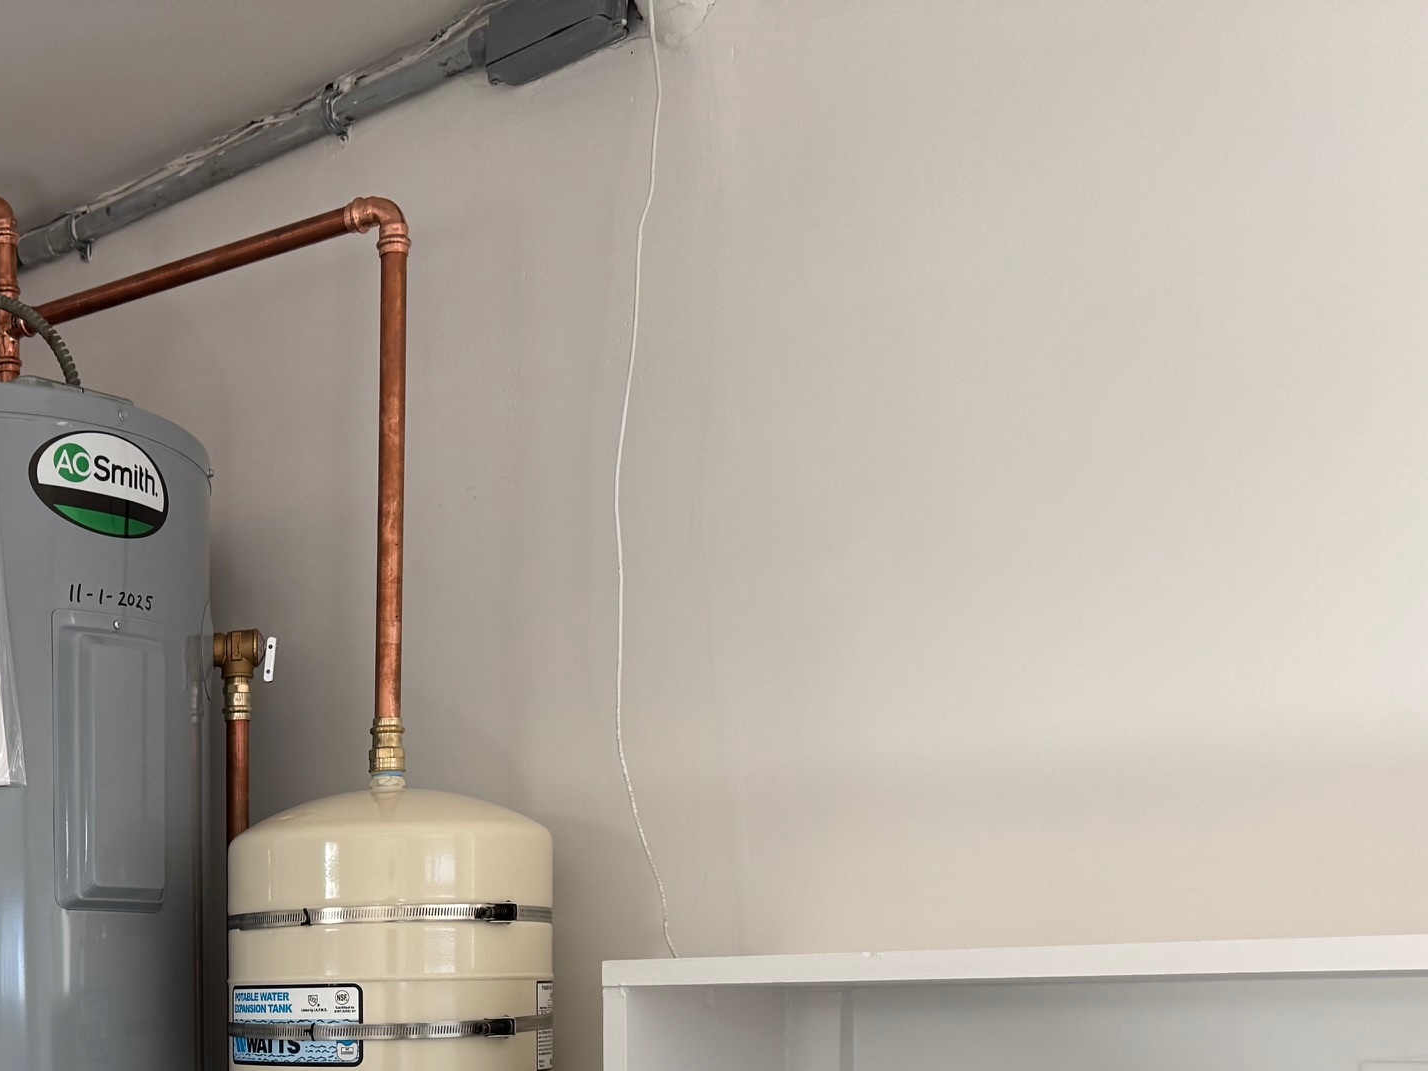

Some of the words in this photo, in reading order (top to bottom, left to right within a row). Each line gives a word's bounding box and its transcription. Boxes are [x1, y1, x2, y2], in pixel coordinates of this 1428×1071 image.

[235, 992, 259, 1002] POTABLE
[260, 992, 290, 1001] WATER
[235, 1004, 267, 1014] EXPANSION
[268, 1003, 293, 1014] TANK
